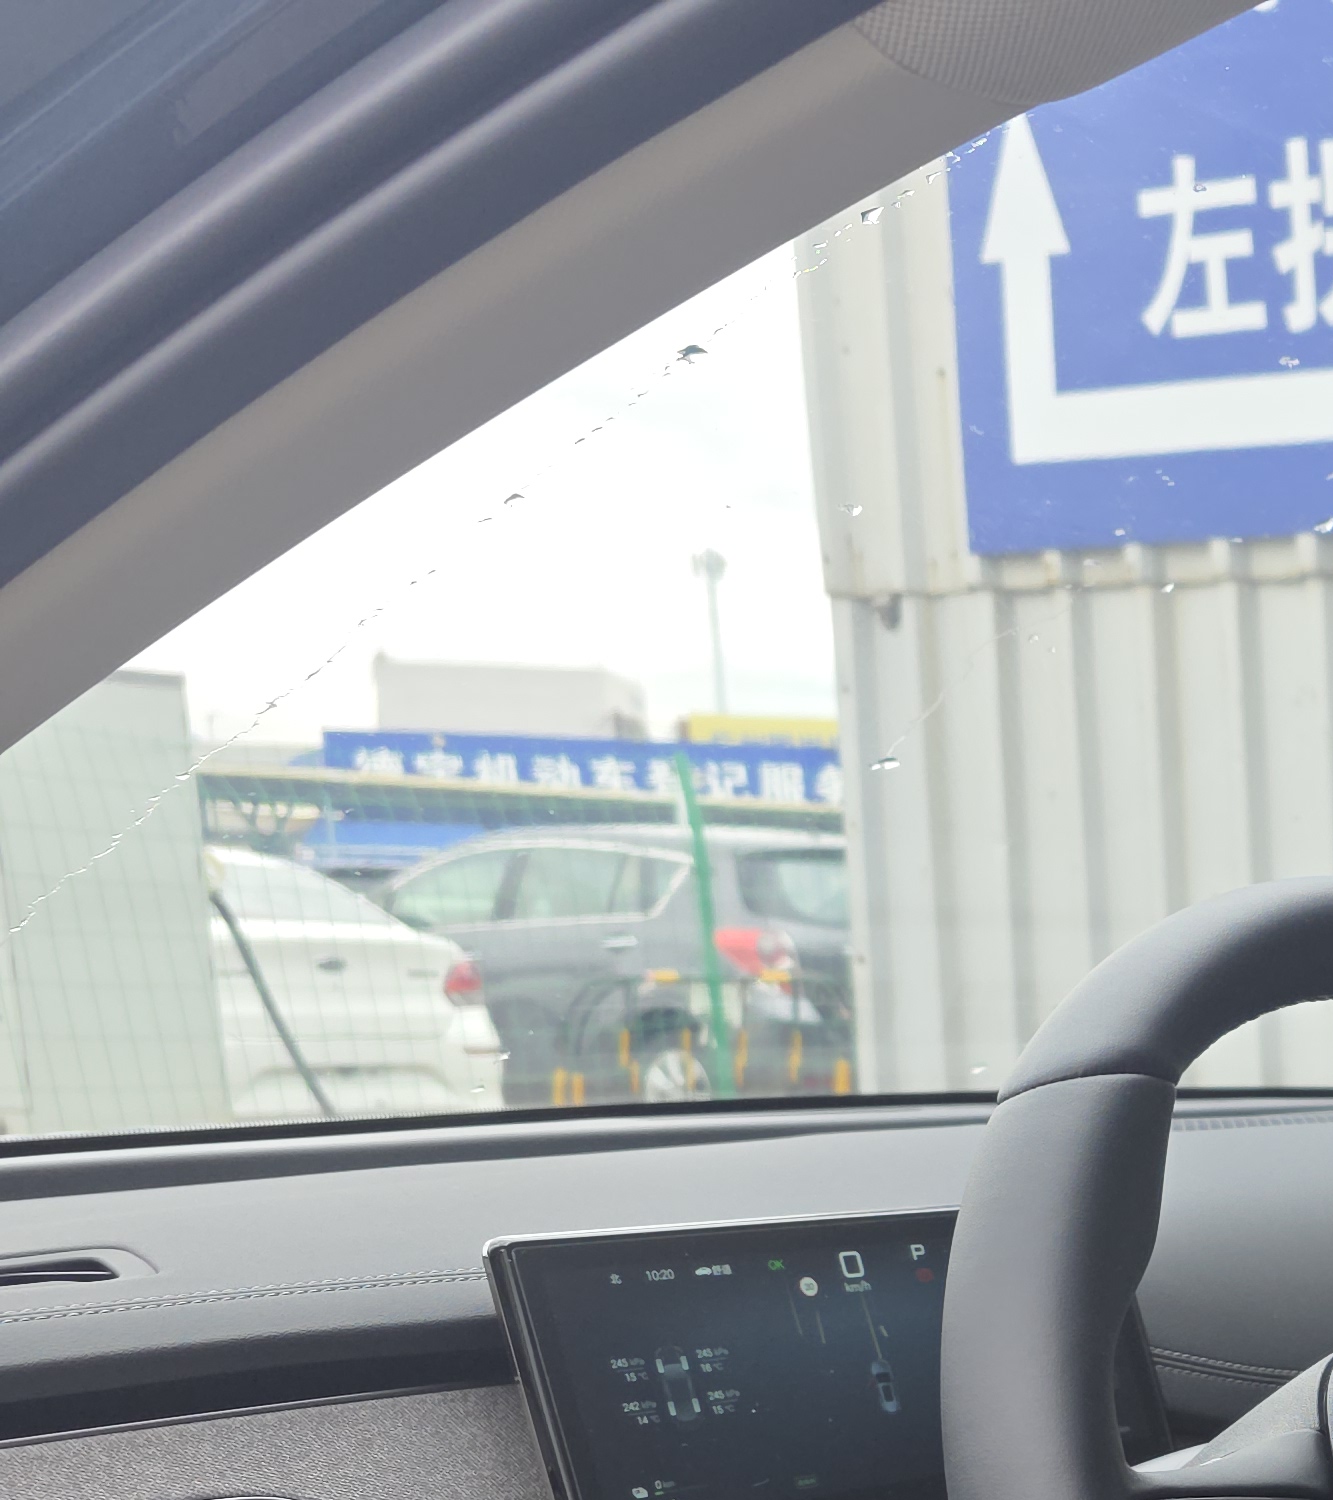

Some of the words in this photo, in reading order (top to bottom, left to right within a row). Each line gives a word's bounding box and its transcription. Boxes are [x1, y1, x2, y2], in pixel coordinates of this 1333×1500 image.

[910, 1244, 925, 1261] P
[767, 1259, 785, 1271] OK
[838, 1250, 865, 1279] 0
[646, 1268, 675, 1281] 10:20
[844, 1279, 872, 1292] km/h
